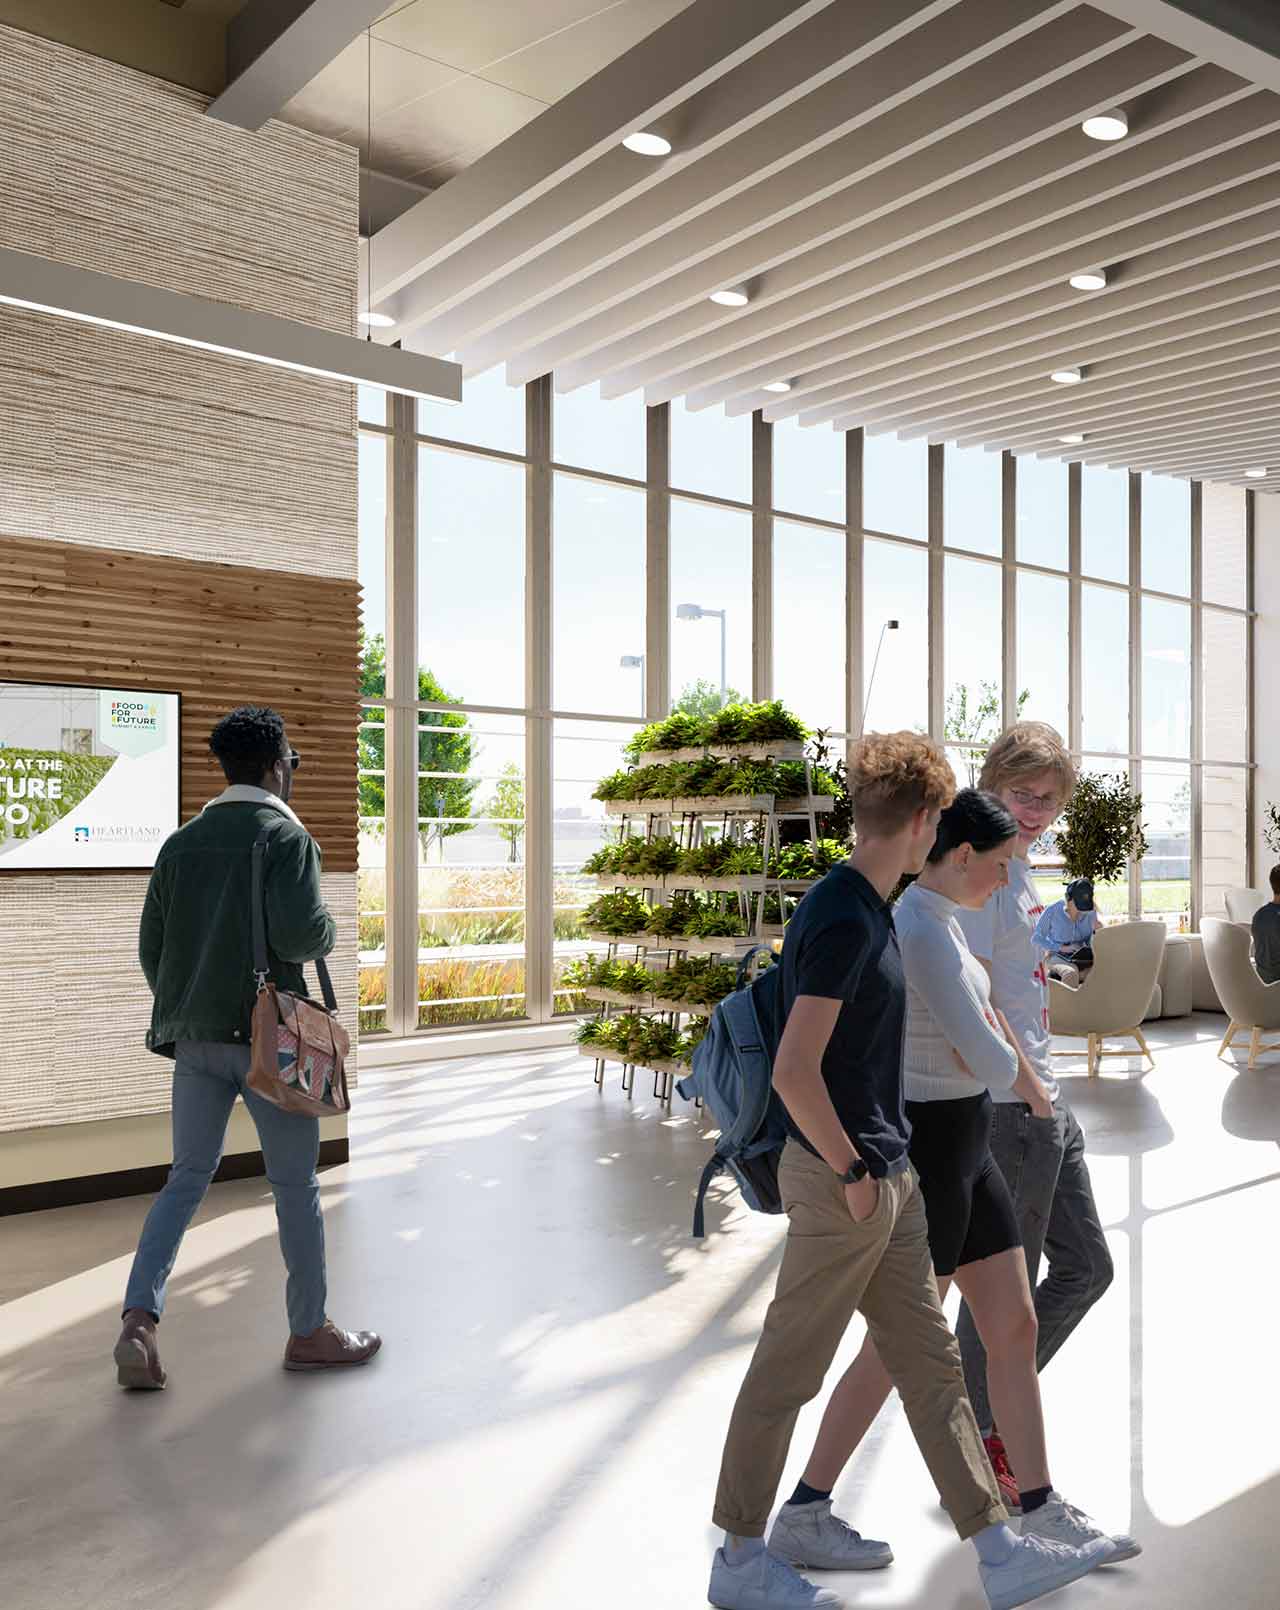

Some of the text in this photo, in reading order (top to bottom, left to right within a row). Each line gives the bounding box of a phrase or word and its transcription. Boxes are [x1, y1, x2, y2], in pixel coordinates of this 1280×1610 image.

[116, 702, 144, 711] FOOD
[111, 709, 131, 717] FOR
[116, 716, 157, 725] FUTURE
[13, 758, 34, 771] AT
[36, 759, 63, 771] THE
